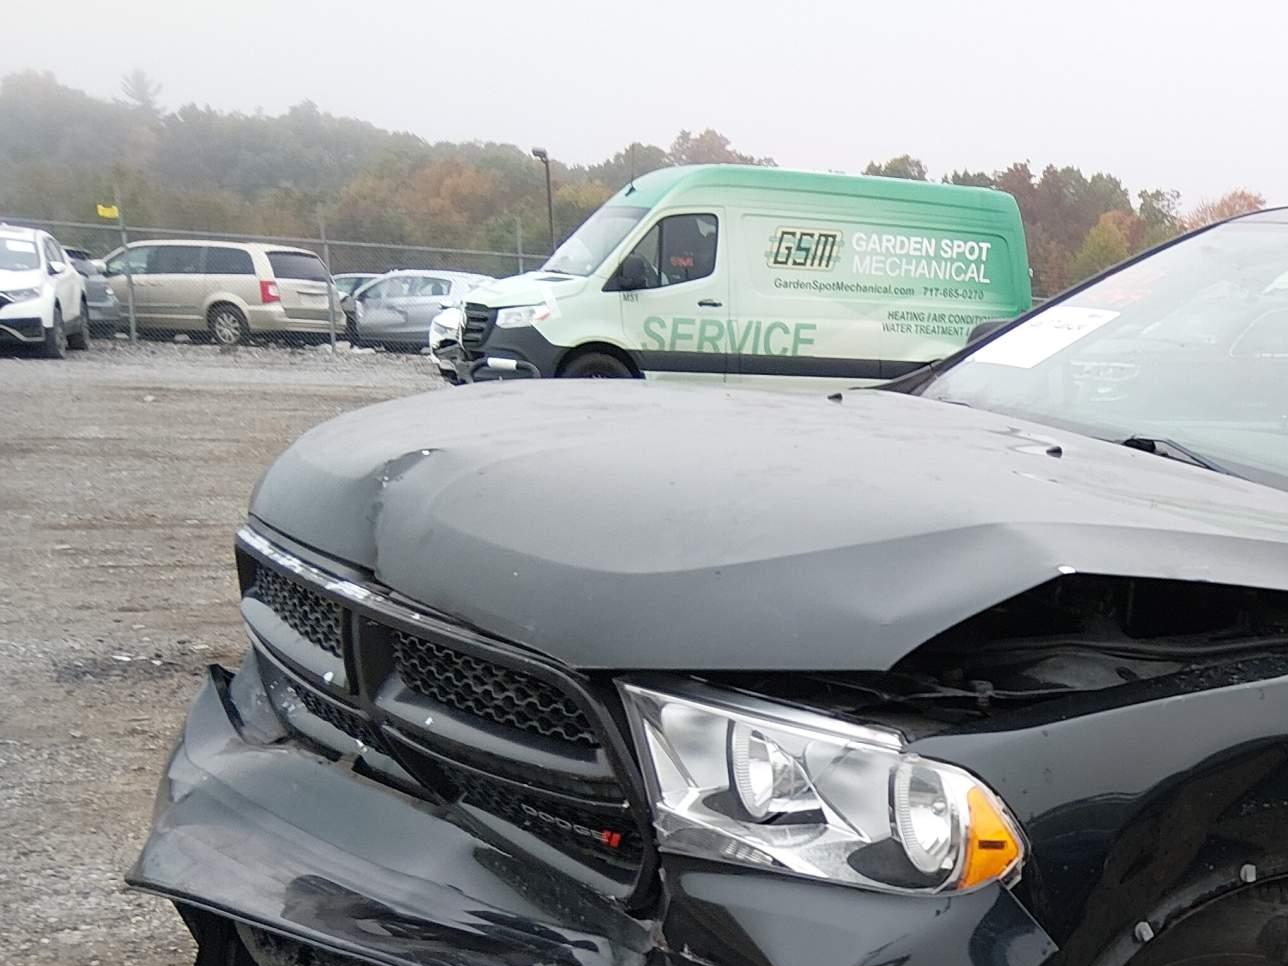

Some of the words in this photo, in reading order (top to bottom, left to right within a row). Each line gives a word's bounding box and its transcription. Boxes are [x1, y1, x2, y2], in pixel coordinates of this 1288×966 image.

[773, 231, 837, 268] GSM
[852, 232, 936, 257] GARDEN
[940, 239, 991, 261] SPOT
[852, 256, 991, 283] MECHANICAL
[774, 278, 915, 296] GardenSpotMechanical.com
[882, 321, 912, 333] WATER
[914, 324, 964, 336] TREATMENT
[888, 311, 925, 321] HEATING
[932, 312, 946, 323] AIR
[641, 315, 817, 357] SERVICE
[521, 802, 607, 841] DODGE
